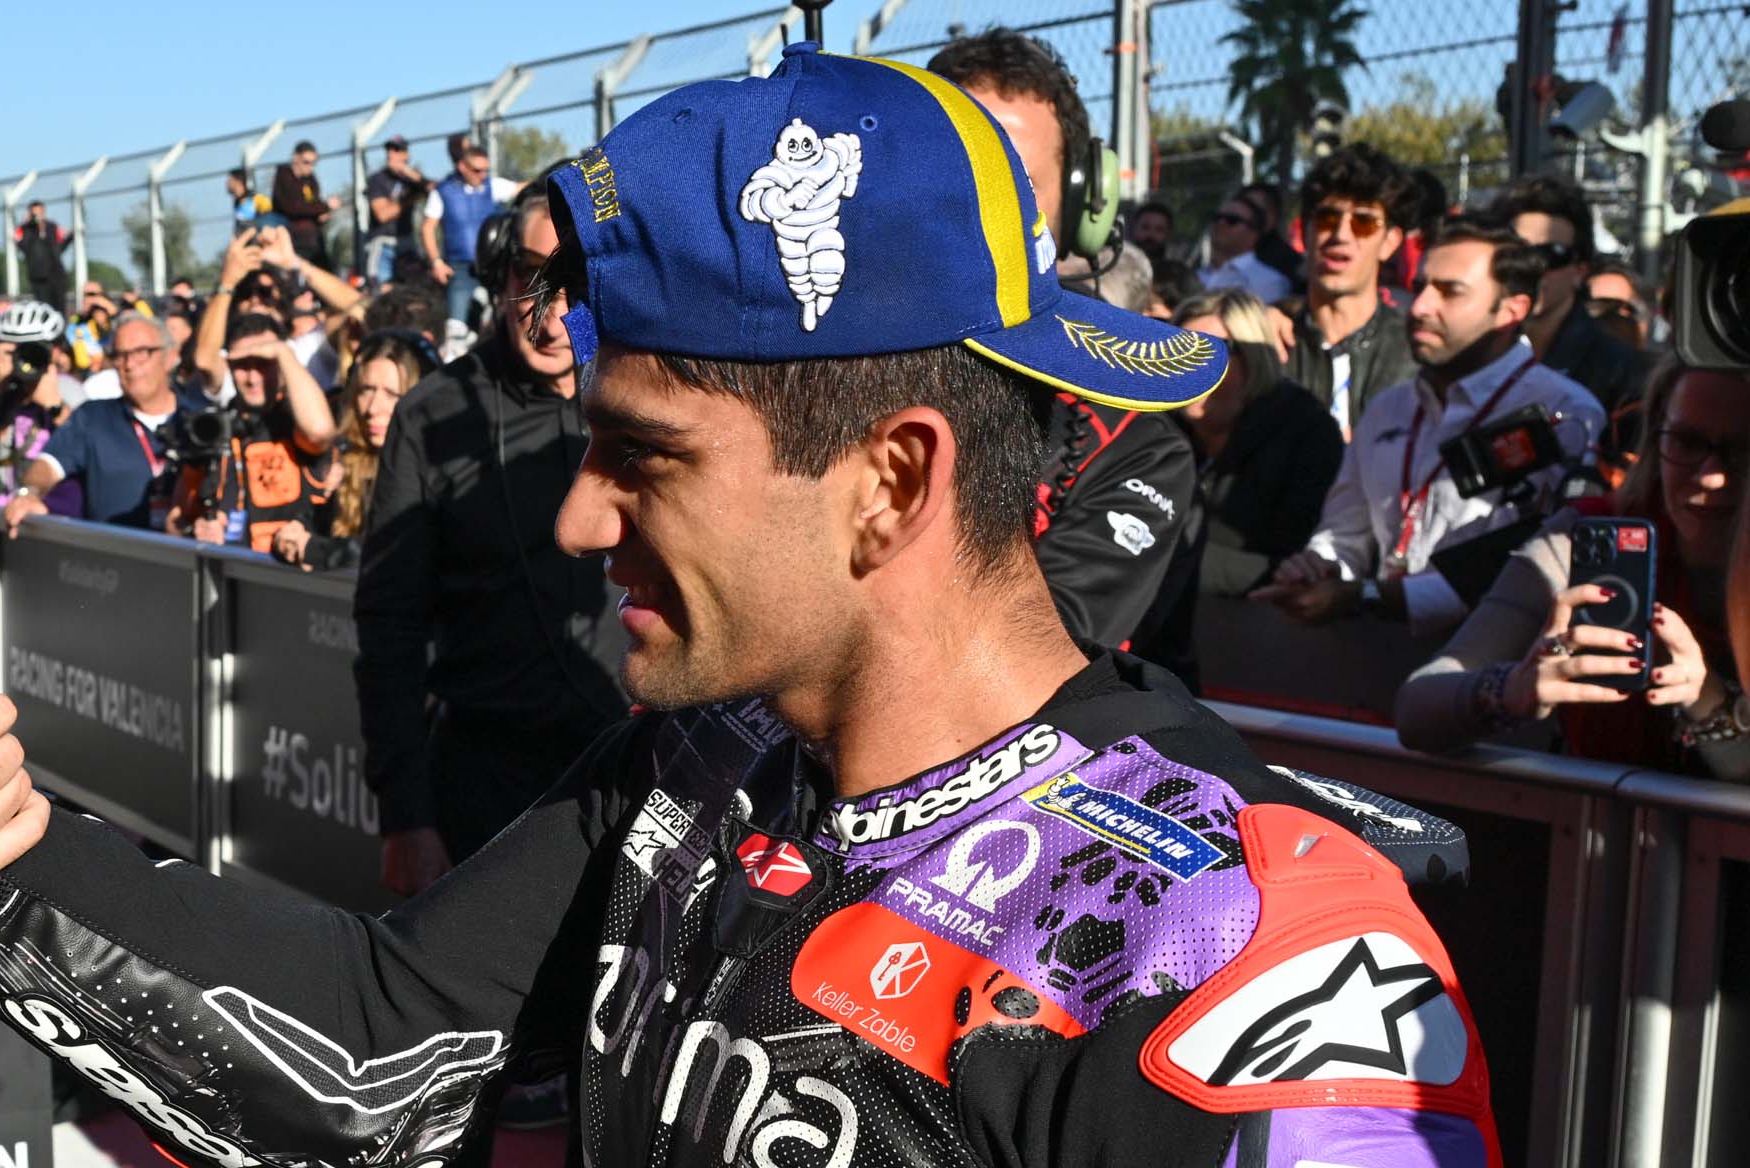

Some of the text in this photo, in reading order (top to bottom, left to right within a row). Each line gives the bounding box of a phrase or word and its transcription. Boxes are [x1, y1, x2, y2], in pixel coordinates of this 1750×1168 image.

[571, 148, 621, 223] MPION
[1124, 478, 1175, 520] ORNA
[1076, 798, 1195, 860] MICHELIN
[886, 876, 1006, 947] PRAMAC
[812, 981, 917, 1054] Keller Zable
